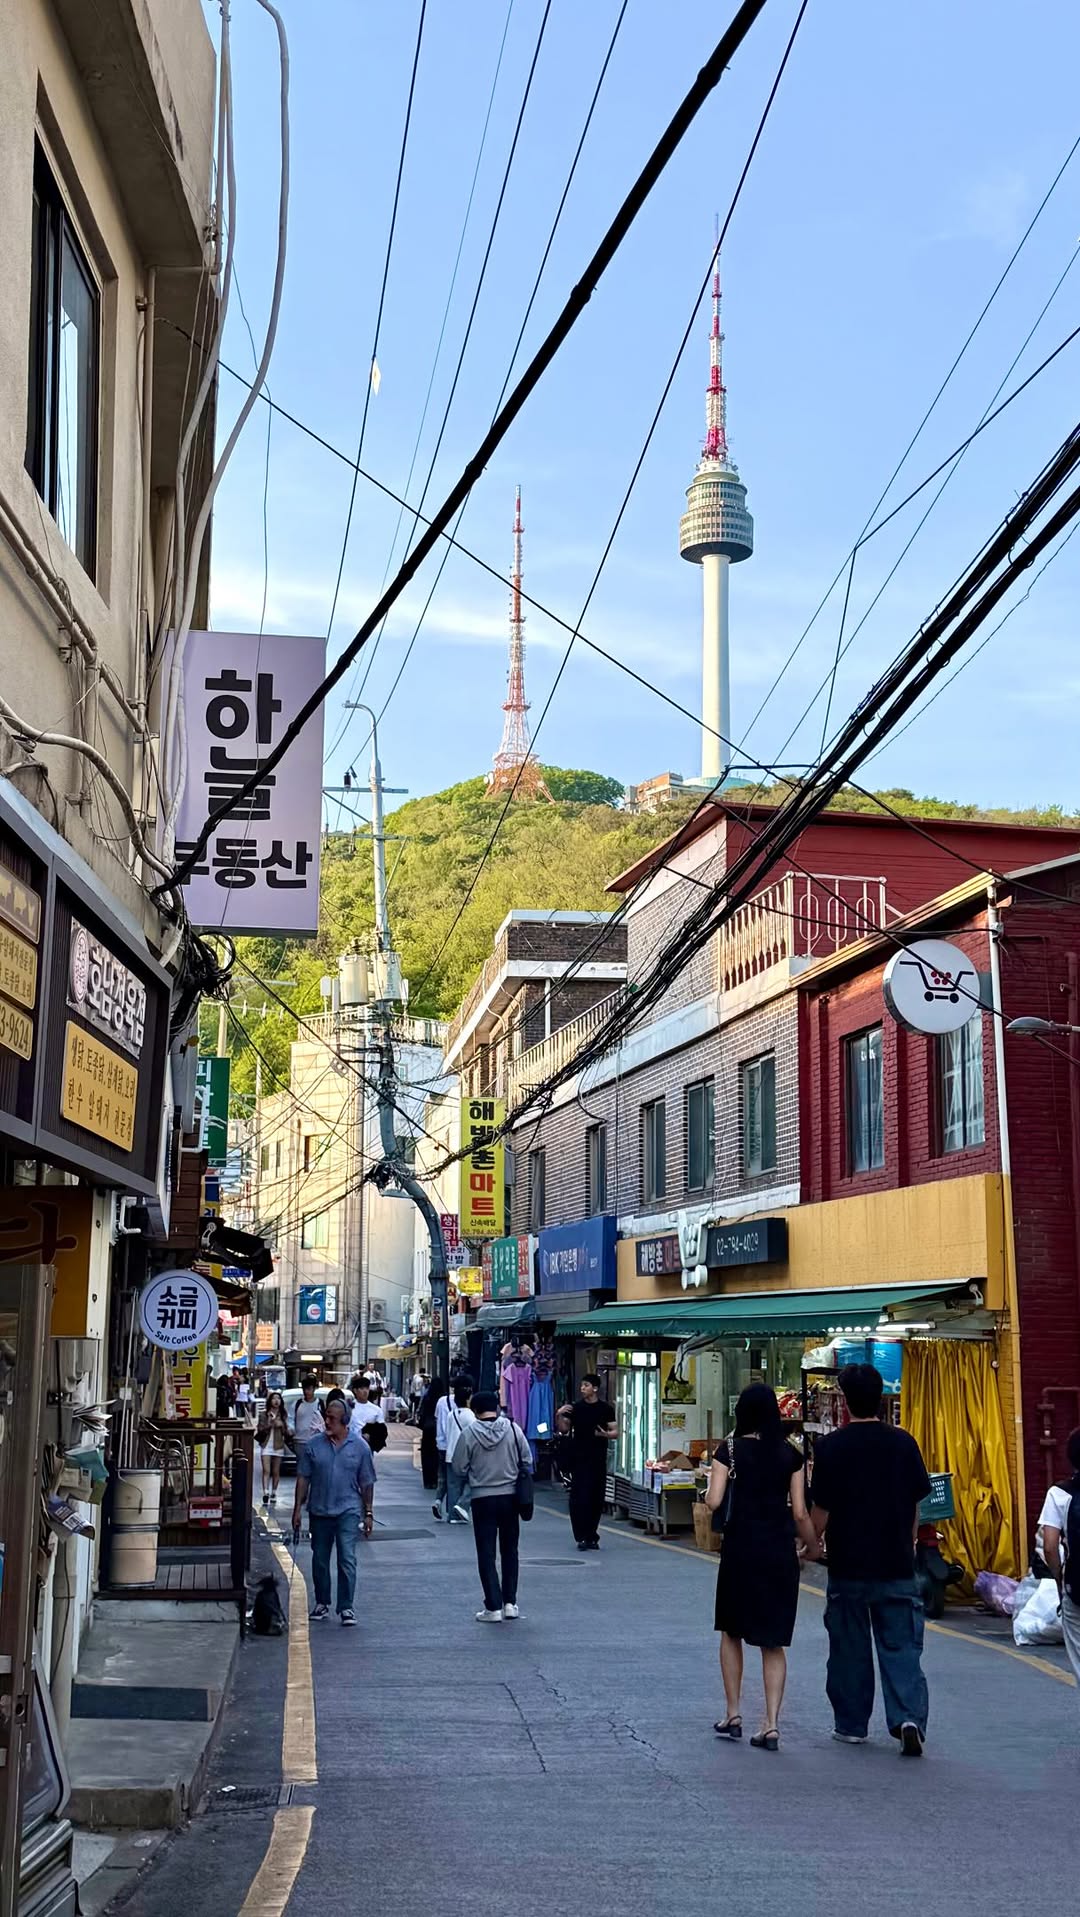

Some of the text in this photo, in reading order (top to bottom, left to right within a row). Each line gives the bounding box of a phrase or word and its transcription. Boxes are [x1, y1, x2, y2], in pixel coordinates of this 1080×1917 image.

[204, 669, 282, 821] 하늘
[174, 837, 313, 889] 부동산
[68, 1077, 84, 1114] 한우
[716, 1232, 759, 1256] 02-794-4029
[158, 1285, 199, 1307] 소금
[157, 1308, 198, 1330] 커피
[154, 1330, 197, 1345] Salt Coffee
